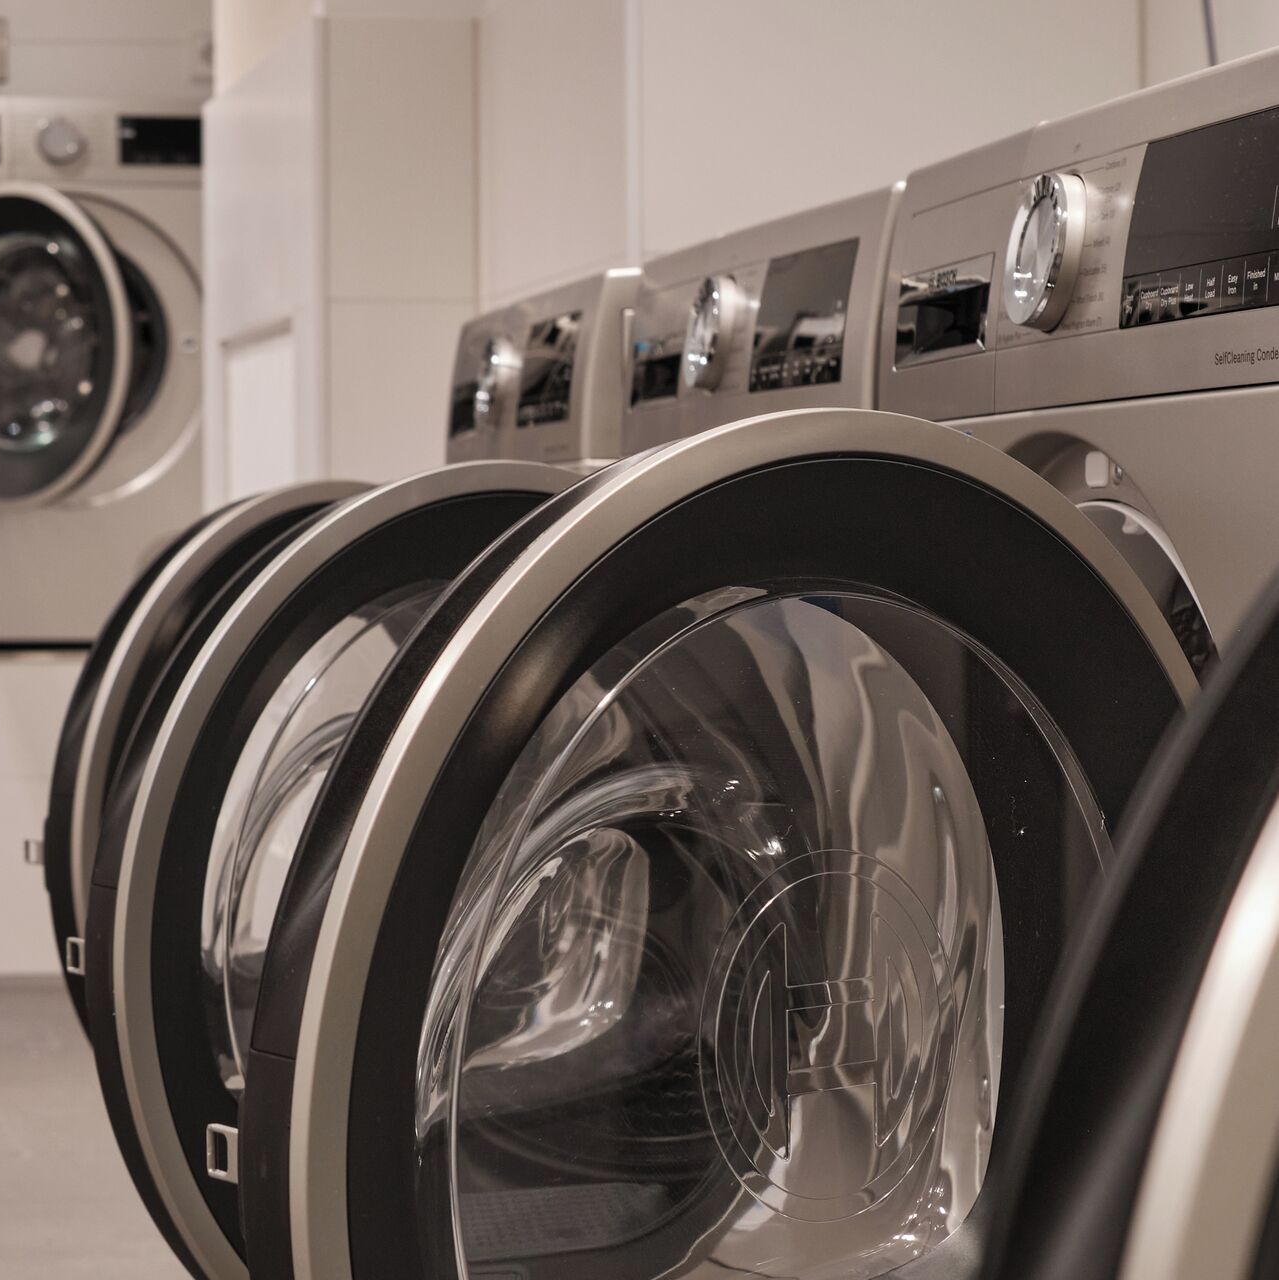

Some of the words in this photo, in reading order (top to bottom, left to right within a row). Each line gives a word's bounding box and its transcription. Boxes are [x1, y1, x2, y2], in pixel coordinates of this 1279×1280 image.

[1247, 268, 1266, 279] Finished
[1206, 277, 1215, 287] Half
[1227, 274, 1238, 284] Easy
[1160, 285, 1179, 295] Cupboard
[1185, 283, 1194, 291] Low
[1227, 286, 1237, 295] Iron
[1140, 288, 1159, 300] Cupboard
[1205, 289, 1215, 298] Load
[1160, 298, 1168, 308] Dry
[1214, 350, 1255, 365] SelfCleaning
